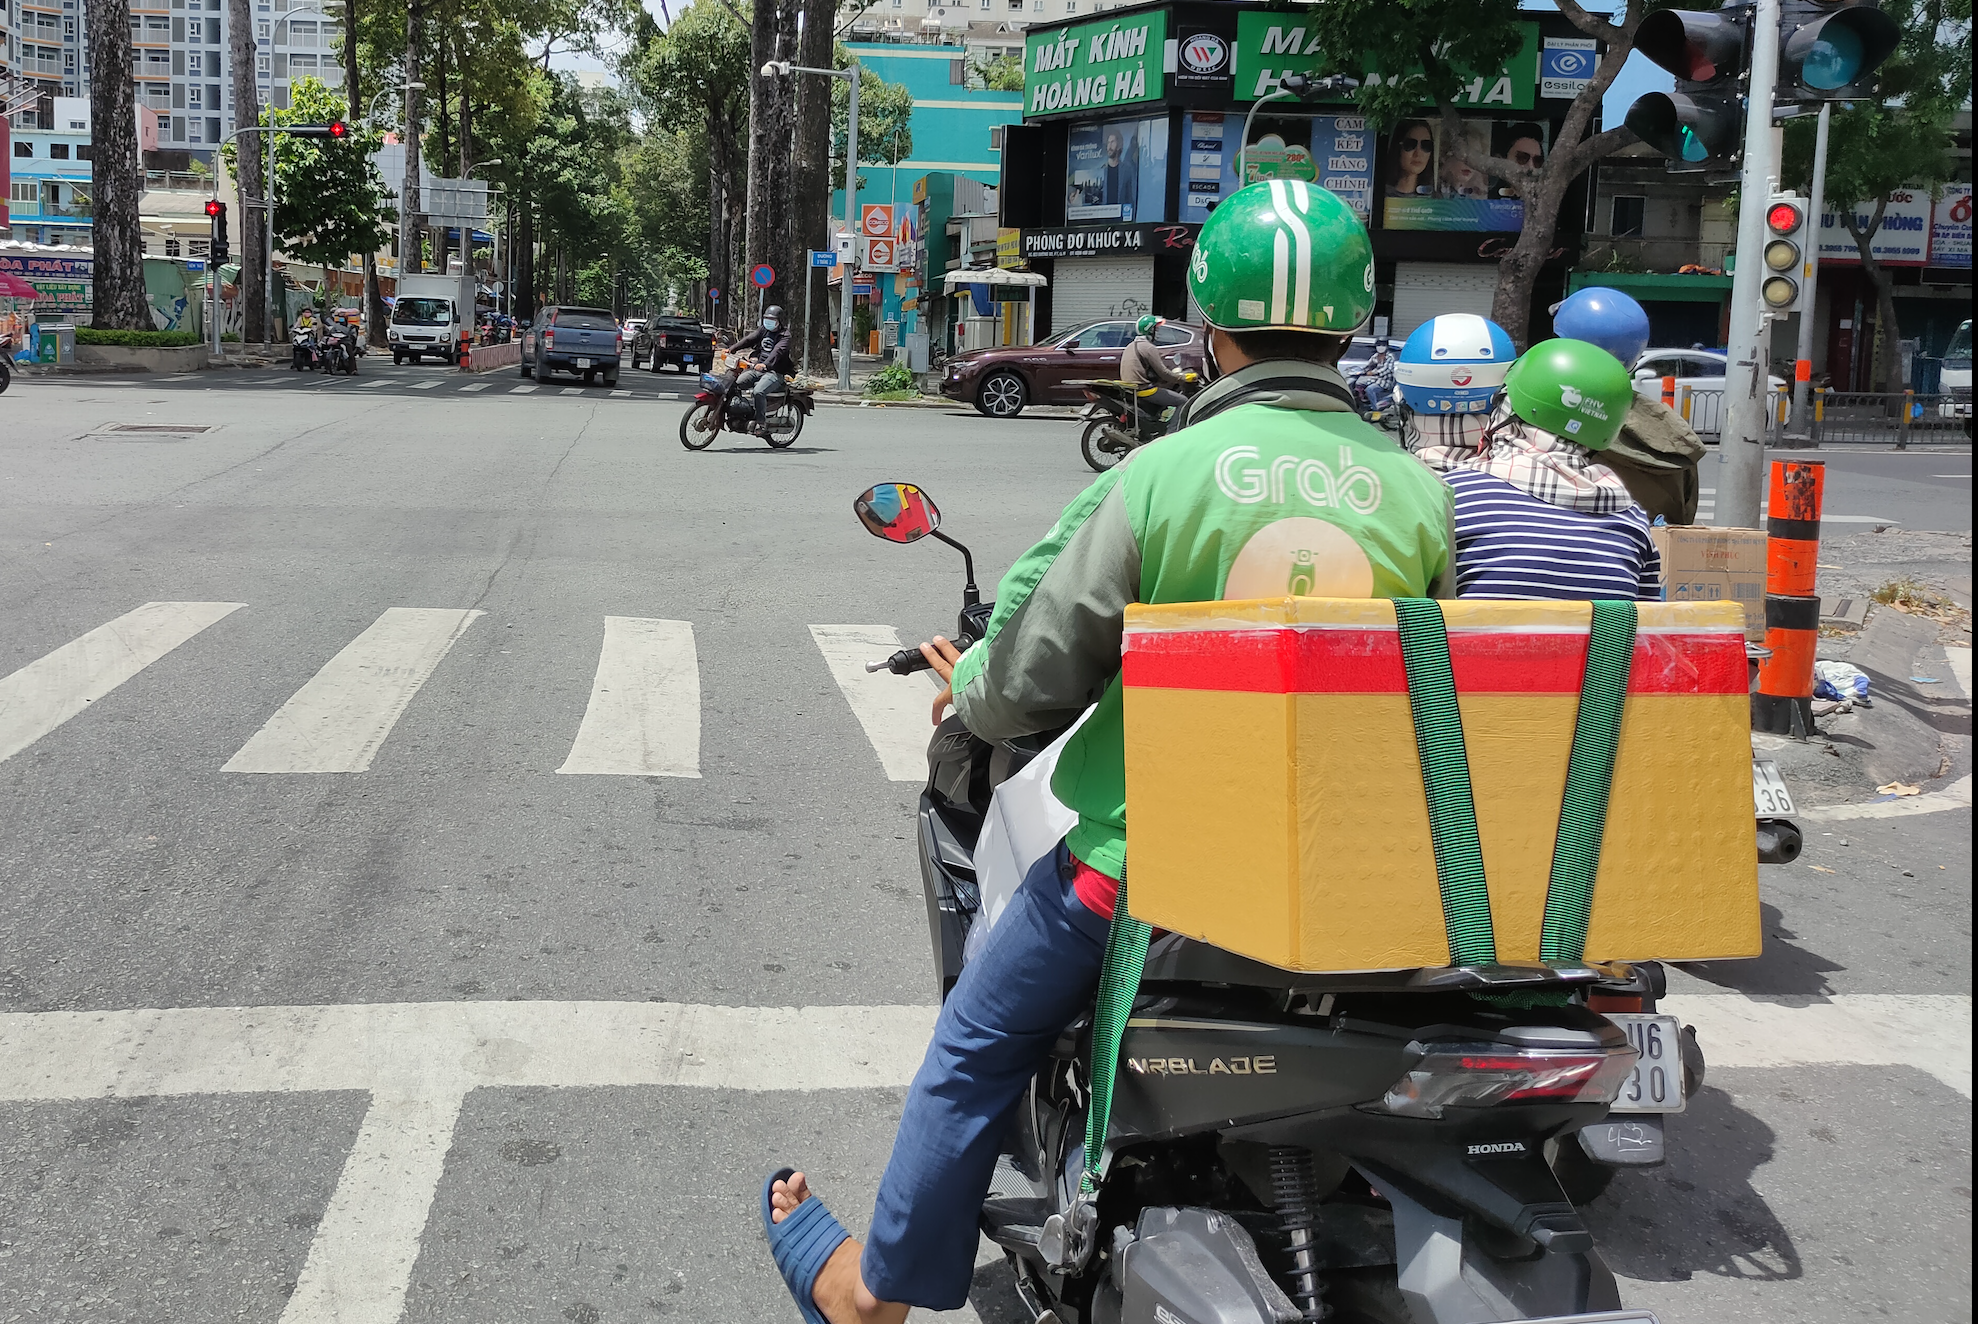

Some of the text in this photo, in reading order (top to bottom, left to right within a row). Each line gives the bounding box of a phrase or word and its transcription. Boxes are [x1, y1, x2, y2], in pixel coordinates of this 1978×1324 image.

[1033, 24, 1149, 73] MẮT KÍNH
[1030, 60, 1146, 112] HOÀNG HÀ
[1544, 81, 1586, 91] essilo
[1325, 176, 1366, 189] CHÍNH
[1882, 212, 1924, 232] HÒNG
[1026, 230, 1064, 251] PHÒNG
[1067, 232, 1085, 249] ĐO
[1087, 226, 1120, 249] KHÚC
[1123, 230, 1142, 251] XẠ
[0, 257, 74, 272] ÒA PHÁT
[1580, 406, 1609, 421] VIETNAM
[1214, 444, 1383, 516] Grab
[1754, 789, 1791, 813] .36
[1626, 1066, 1666, 1103] 30
[1467, 1142, 1526, 1155] HONDA
